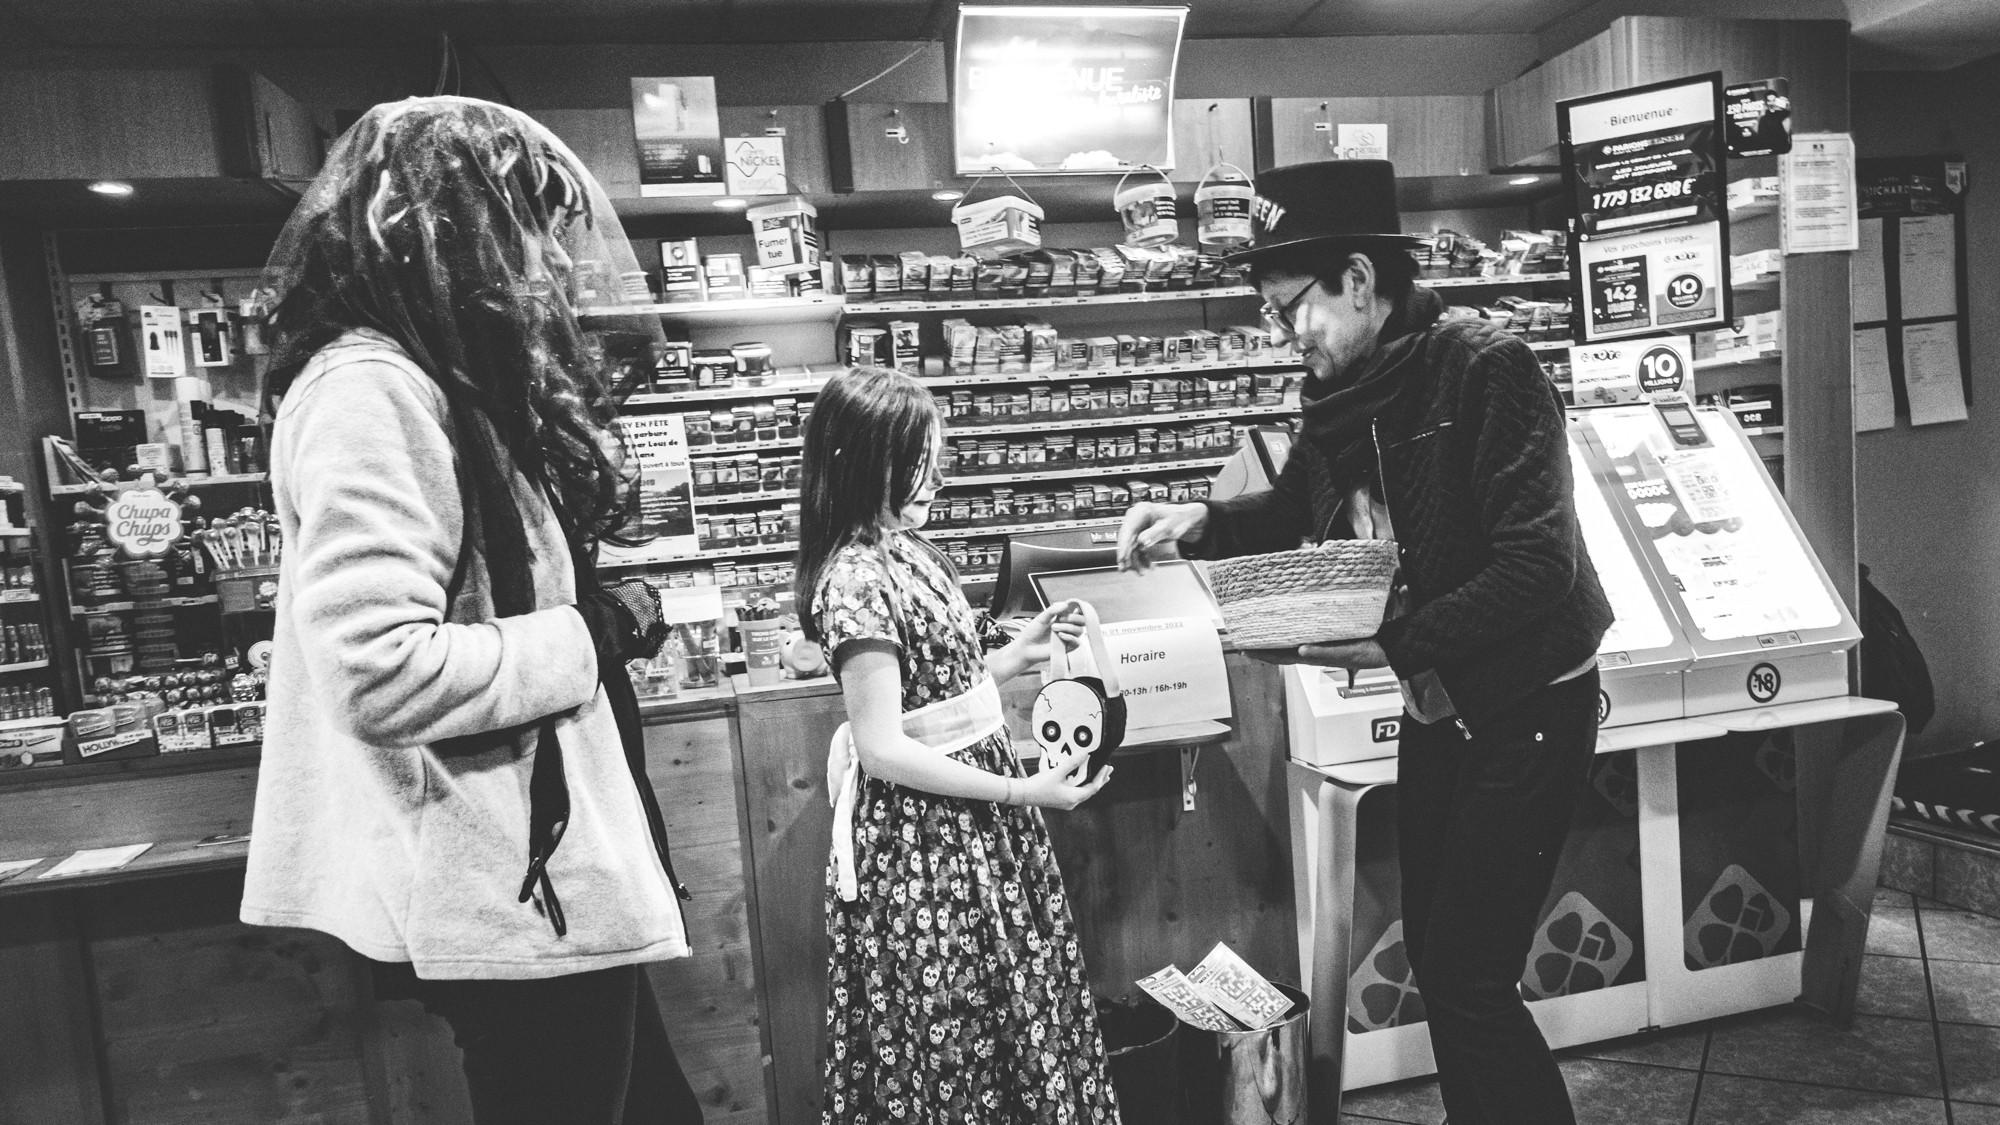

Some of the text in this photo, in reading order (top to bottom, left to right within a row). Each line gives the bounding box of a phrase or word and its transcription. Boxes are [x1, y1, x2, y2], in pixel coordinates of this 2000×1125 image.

[968, 65, 1126, 92] BENUE
[1610, 106, 1674, 127] Bienvenue
[1601, 190, 1628, 209] 779
[1629, 185, 1653, 204] 132
[1653, 180, 1682, 200] 698
[758, 237, 789, 249] Fumer
[767, 250, 783, 260] tue
[1603, 284, 1638, 303] 142
[1671, 278, 1698, 296] 10
[1643, 353, 1677, 379] 10
[635, 421, 647, 429] EN
[649, 419, 669, 428] FÊTE
[634, 431, 668, 439] garbure
[648, 440, 667, 448] Lous
[116, 504, 171, 523] Chupa
[116, 520, 171, 546] Chups
[1121, 624, 1162, 634] novembre
[1163, 621, 1184, 629] 2022
[1120, 650, 1166, 665] Horaire
[1154, 681, 1188, 693] 16h-19h
[1375, 720, 1400, 739] FD
